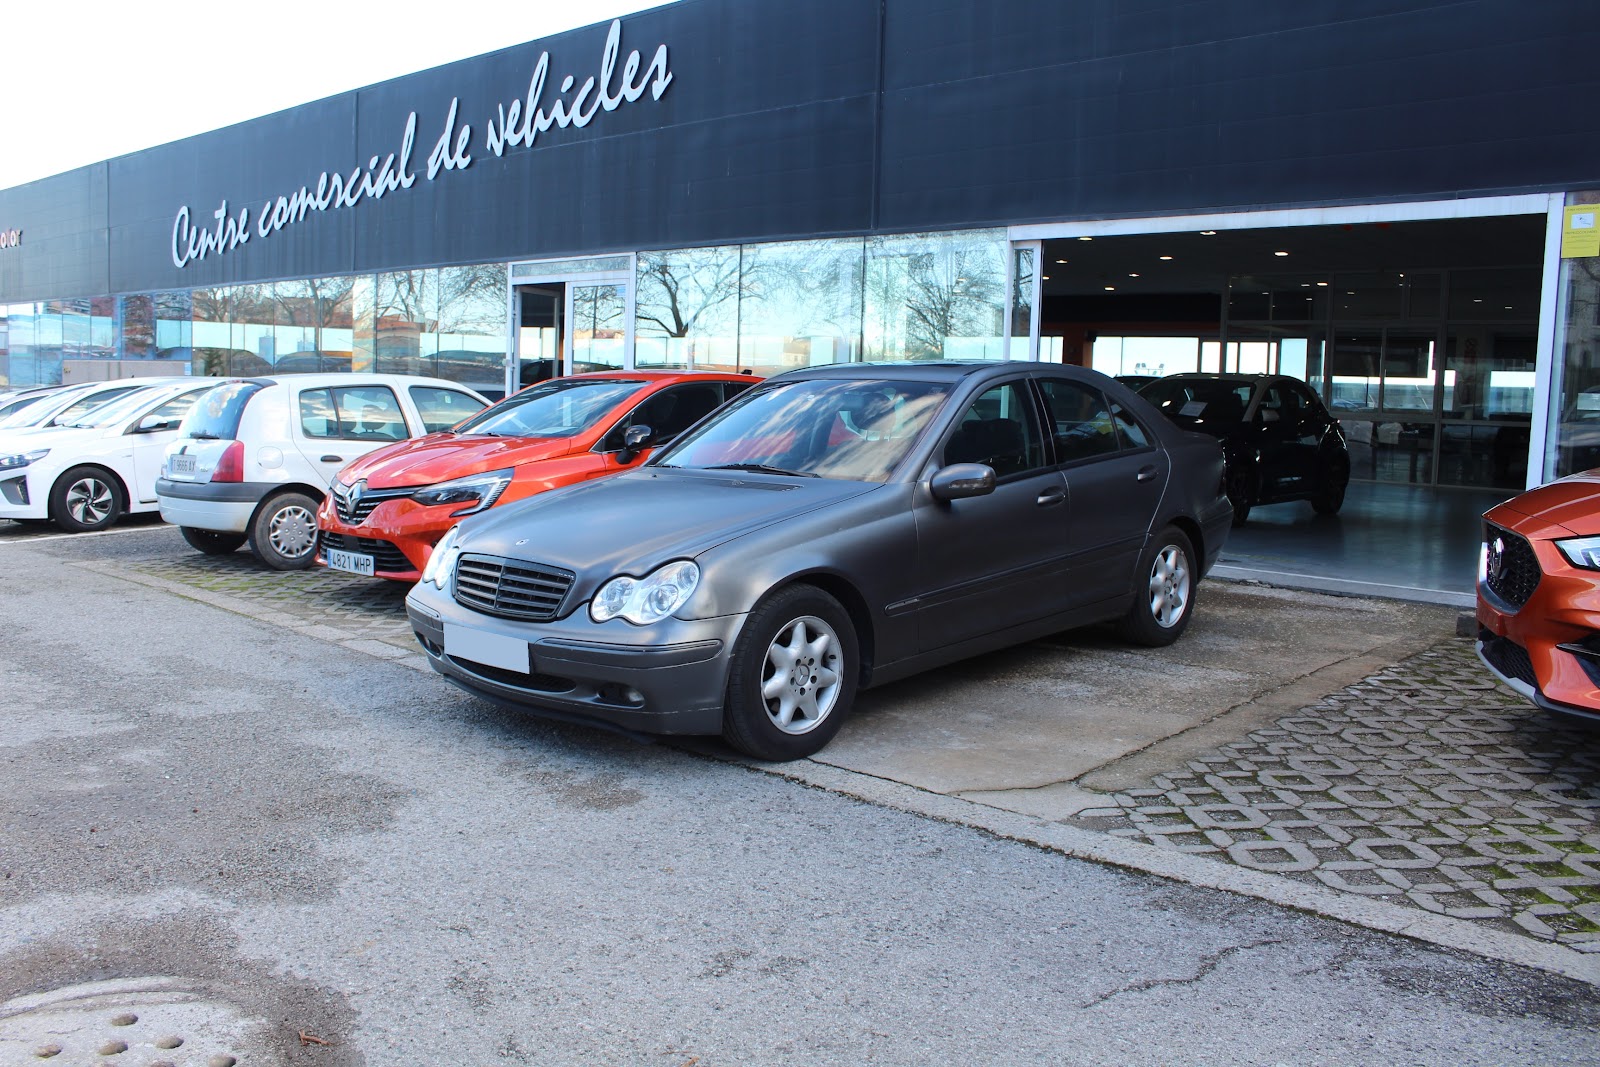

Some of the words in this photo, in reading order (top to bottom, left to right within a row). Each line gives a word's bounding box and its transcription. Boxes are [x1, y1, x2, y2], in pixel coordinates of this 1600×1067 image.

[172, 200, 250, 268] Centre
[258, 112, 417, 238] comercial
[427, 97, 472, 181] de
[487, 19, 673, 157] vehicles
[332, 552, 351, 569] 4821
[353, 556, 371, 572] MHP
